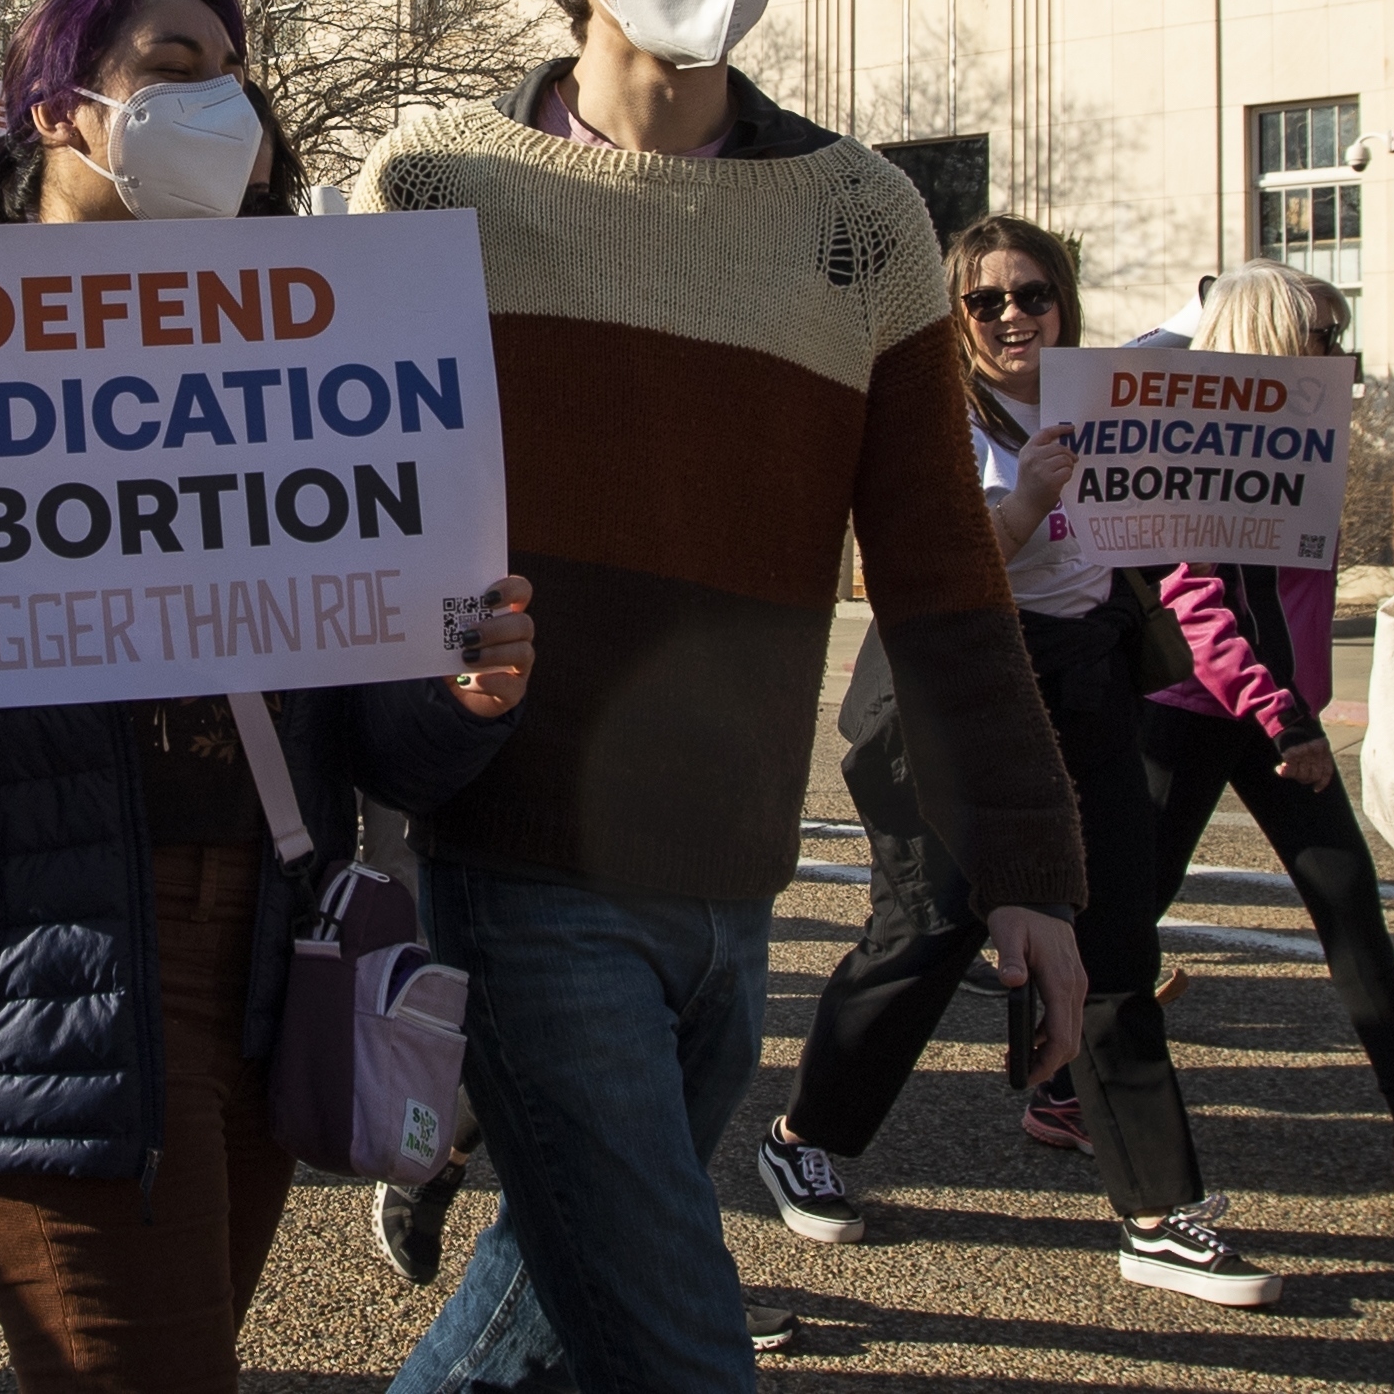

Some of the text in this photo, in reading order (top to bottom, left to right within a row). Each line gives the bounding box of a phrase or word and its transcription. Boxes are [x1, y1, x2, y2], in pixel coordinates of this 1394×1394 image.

[1110, 371, 1288, 414] DEFEND
[1058, 418, 1336, 464] MEDICATION
[1077, 466, 1305, 507] ABORTION
[1088, 514, 1166, 552] BIGGER
[1169, 514, 1238, 551] THAN
[1239, 517, 1286, 551] ROE
[144, 576, 302, 662] THAN
[312, 569, 407, 651] ROE
